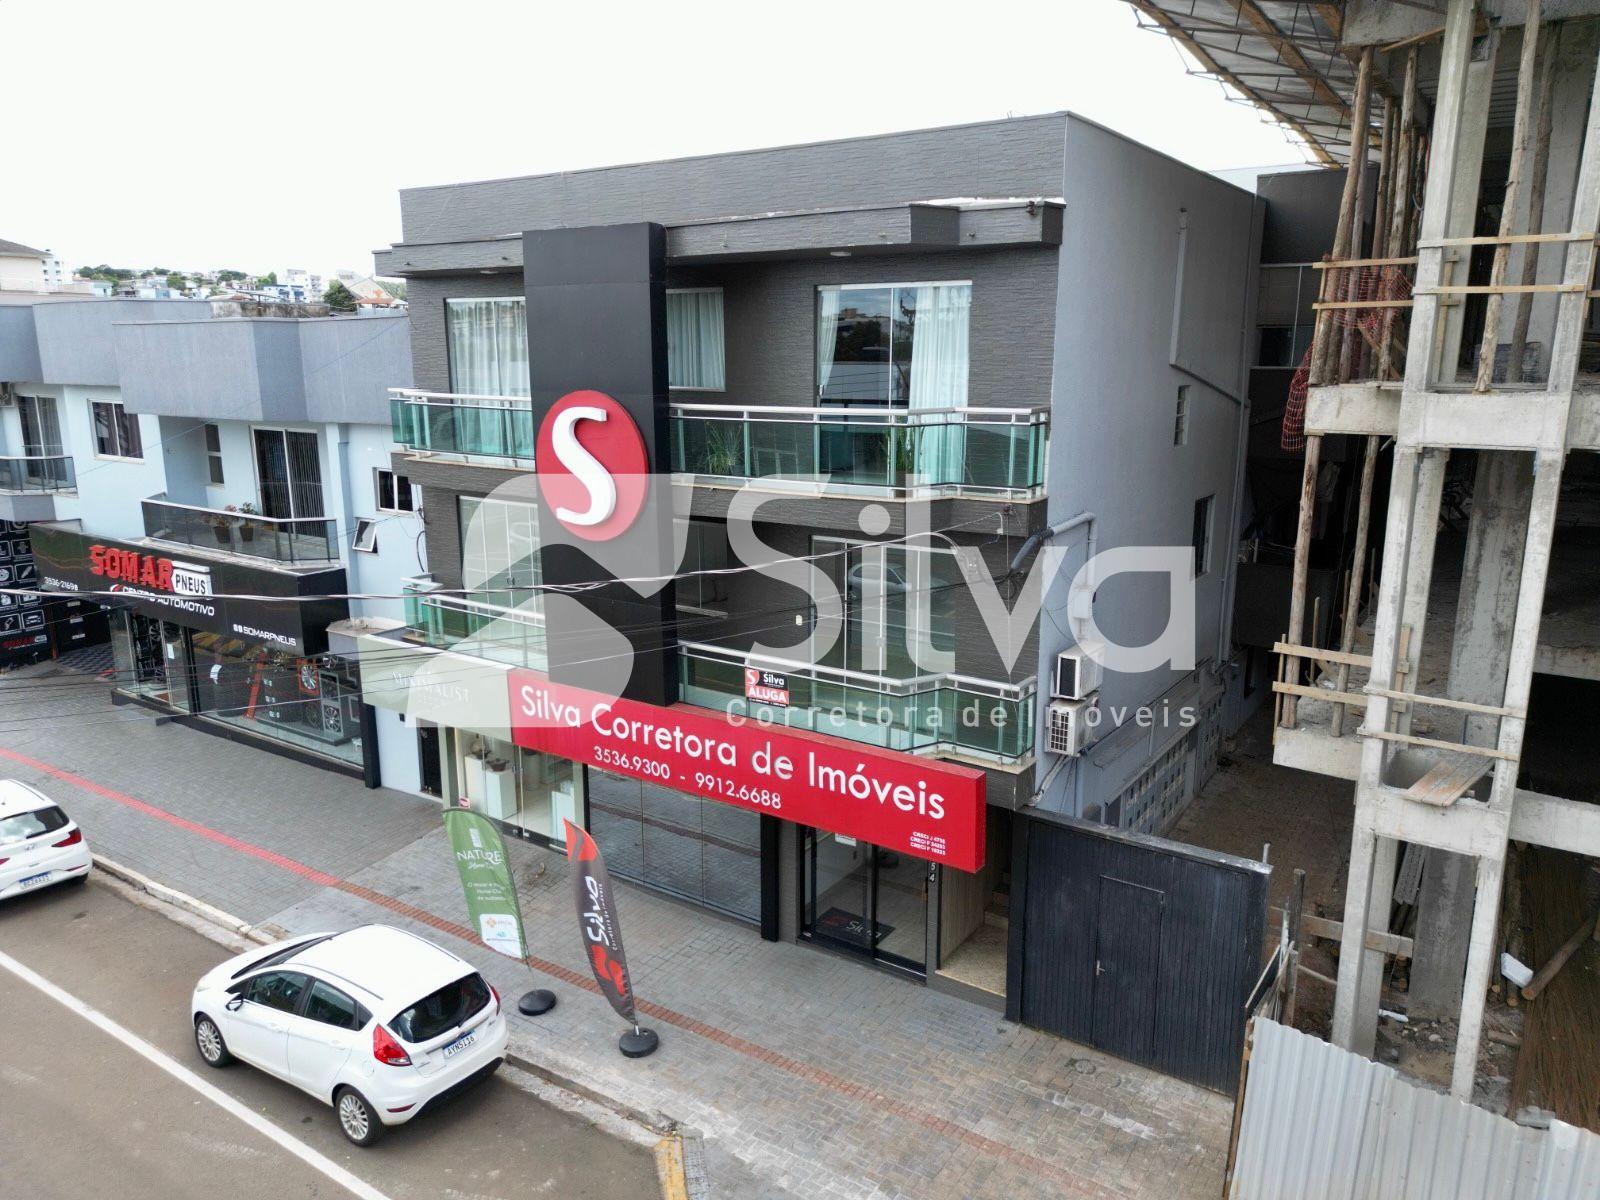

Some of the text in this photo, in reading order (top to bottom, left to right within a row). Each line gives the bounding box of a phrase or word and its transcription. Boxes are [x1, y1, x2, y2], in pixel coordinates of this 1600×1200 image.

[88, 544, 175, 592] SOMAR
[175, 573, 207, 595] PNEUS
[157, 598, 215, 616] AUTOMOTIVO
[243, 626, 297, 646] SOMARPNEUS
[763, 673, 785, 686] Silva
[749, 686, 787, 702] ALUGA
[521, 685, 946, 820] Silva Corretora de Imóveis
[593, 746, 671, 779] 3536.9300
[695, 773, 782, 810] 9912.6688
[456, 850, 503, 864] NATURE
[584, 875, 610, 947] Silva
